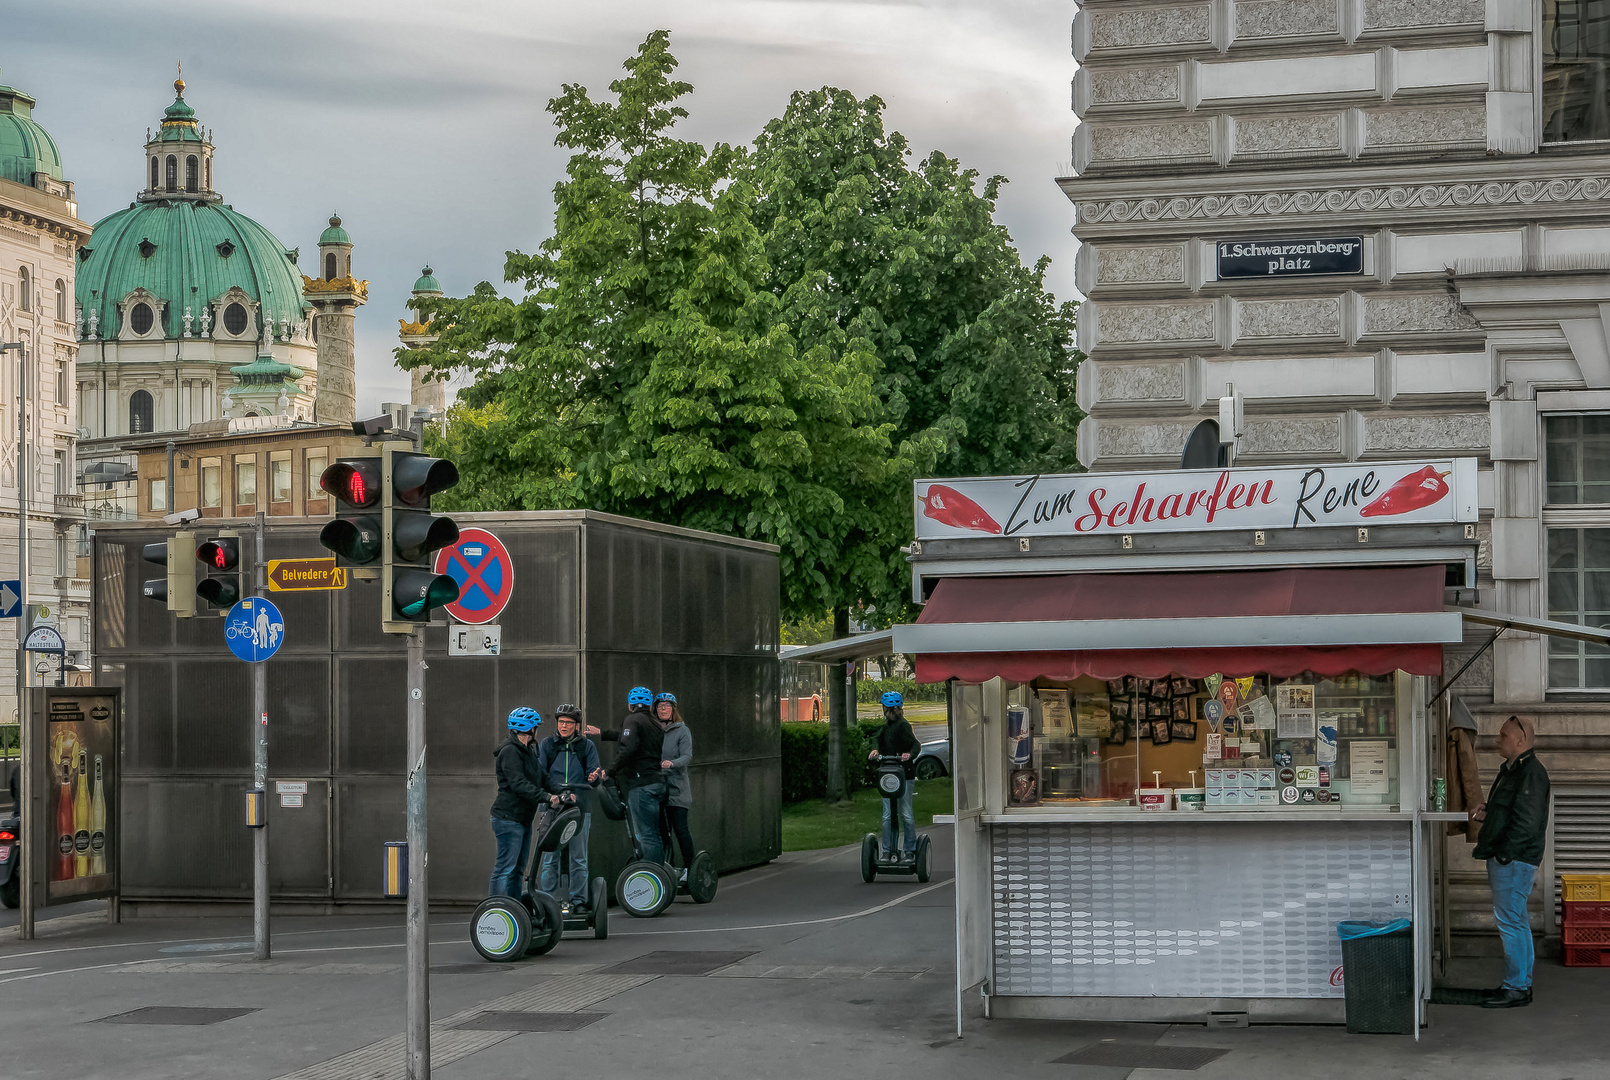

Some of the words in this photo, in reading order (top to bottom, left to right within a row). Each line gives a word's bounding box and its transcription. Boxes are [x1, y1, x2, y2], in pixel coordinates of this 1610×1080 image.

[1268, 257, 1311, 274] platz
[1003, 474, 1077, 536] Zum
[1073, 470, 1278, 533] Scharfen
[1292, 467, 1381, 529] Rene
[282, 568, 328, 581] Belvedere
[33, 629, 55, 639] AUTOBUS
